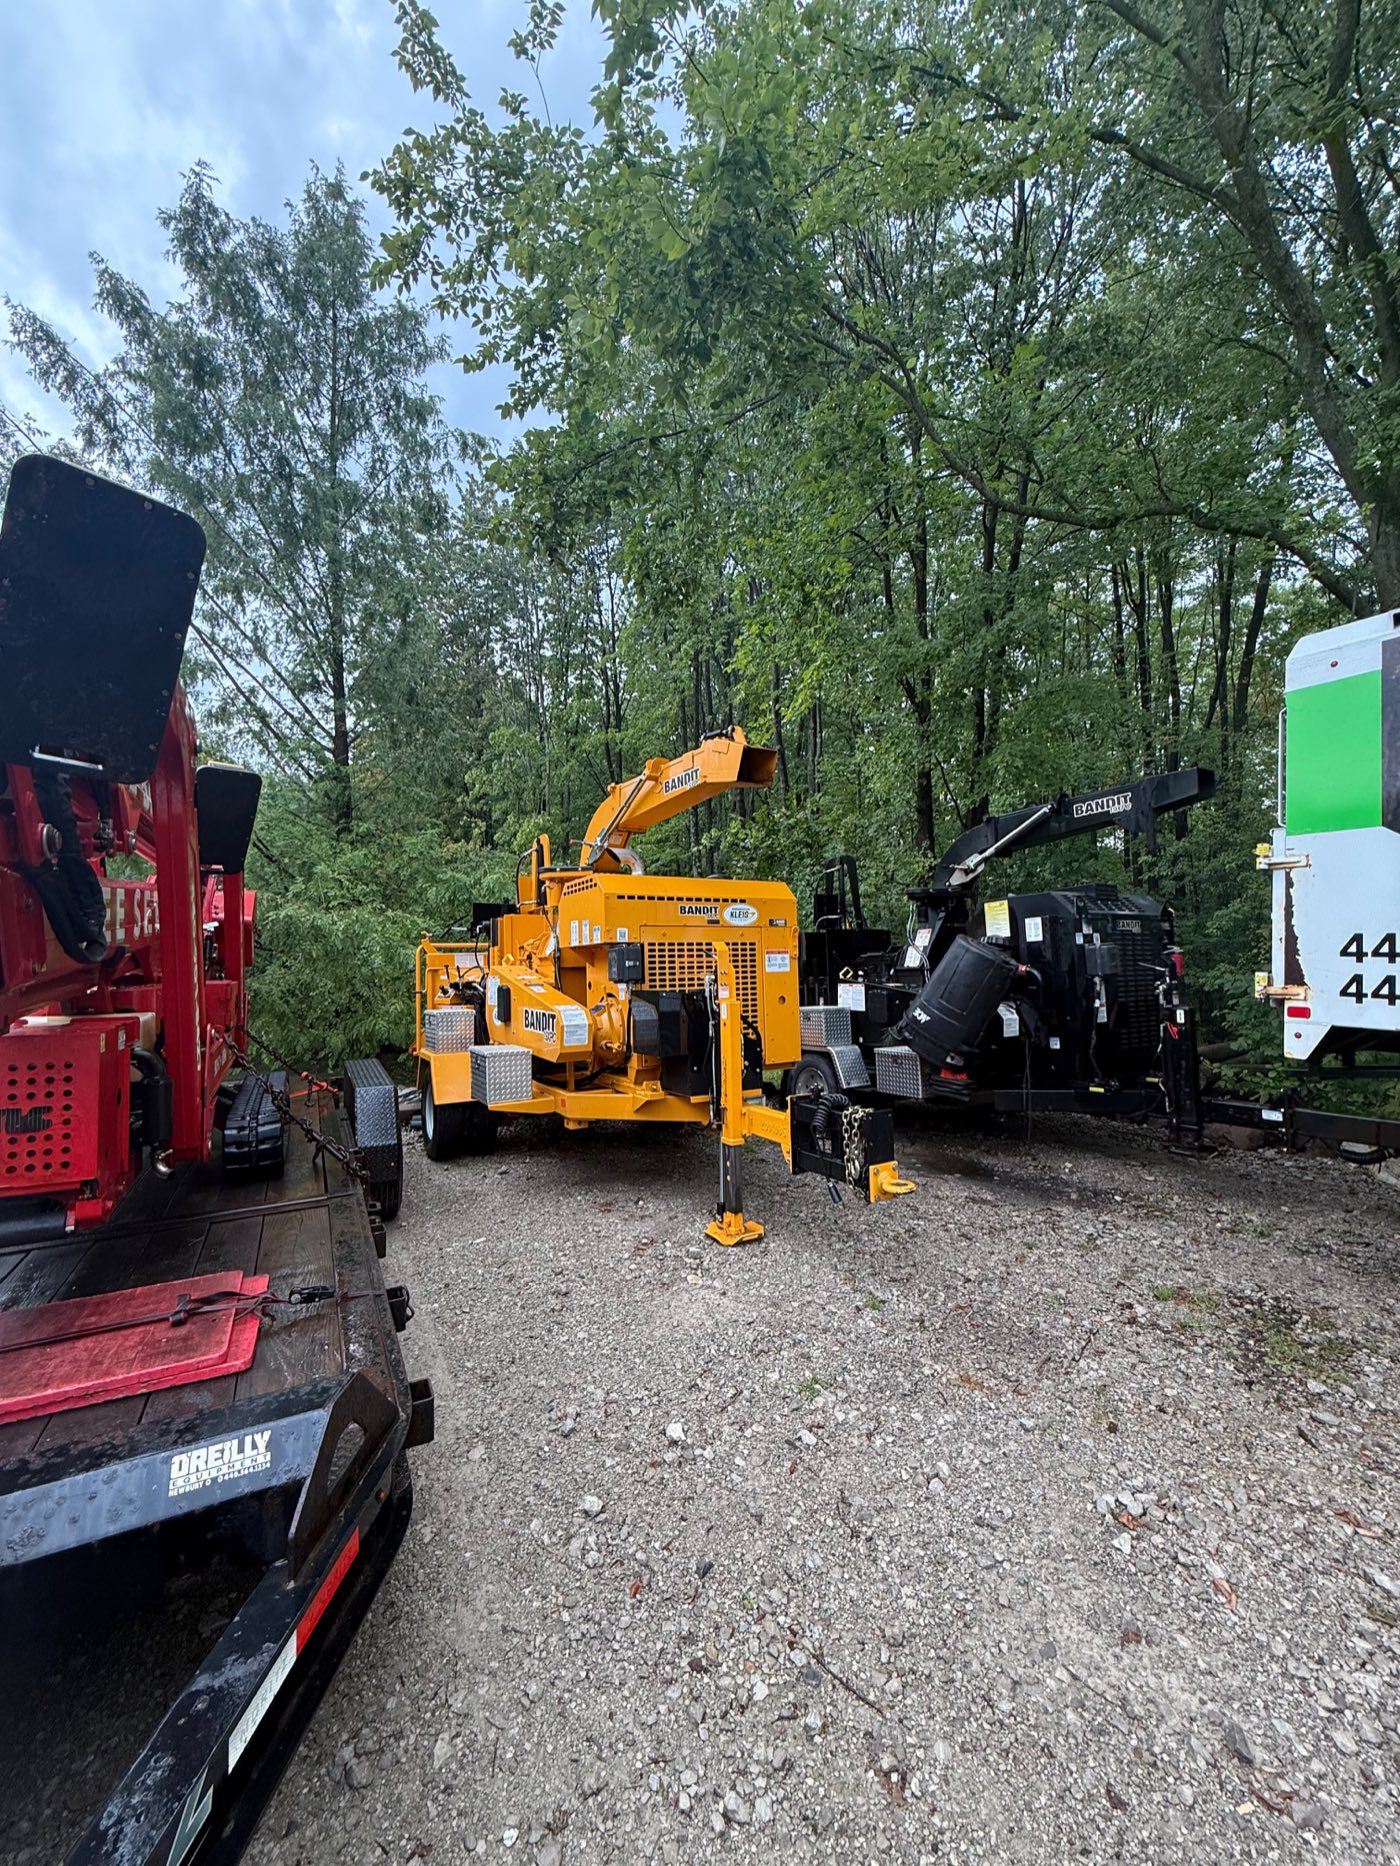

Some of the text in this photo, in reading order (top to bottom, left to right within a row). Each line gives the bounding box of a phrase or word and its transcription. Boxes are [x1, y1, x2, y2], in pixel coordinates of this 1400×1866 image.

[663, 767, 700, 794] BANDIT
[1073, 793, 1132, 818] BANDIT
[679, 905, 719, 916] BANDIT
[730, 910, 749, 919] KLEIS
[524, 1008, 557, 1033] BANDIT
[171, 1454, 270, 1488] EQUIPMENT
[168, 1480, 204, 1498] NEWBURY
